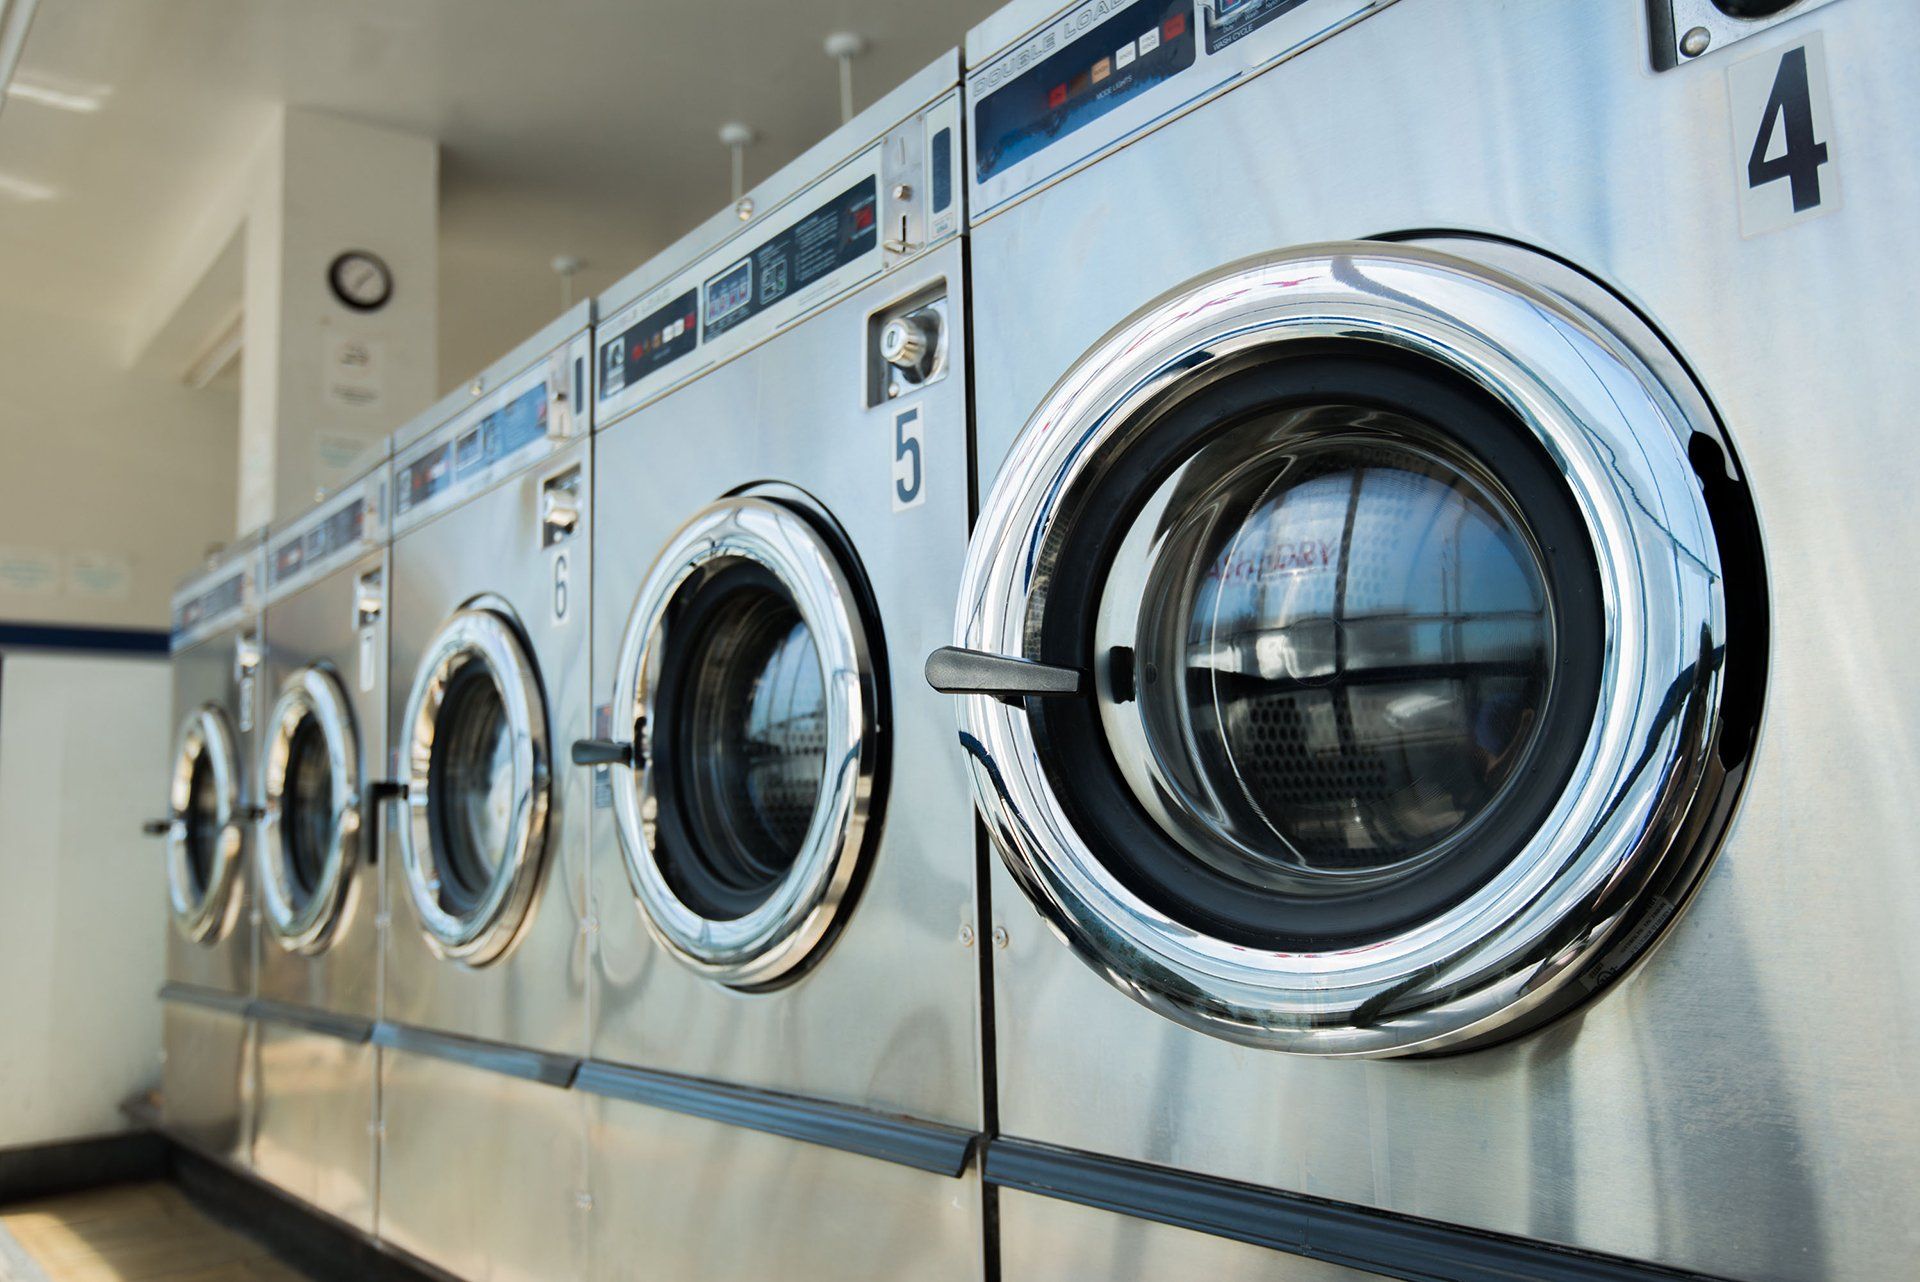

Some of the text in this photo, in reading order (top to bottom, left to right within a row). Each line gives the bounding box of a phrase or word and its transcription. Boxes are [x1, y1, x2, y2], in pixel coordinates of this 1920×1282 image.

[973, 32, 1056, 97] DOUBLE
[1748, 46, 1828, 213] 4
[896, 407, 921, 503] 5
[555, 555, 567, 618] 6
